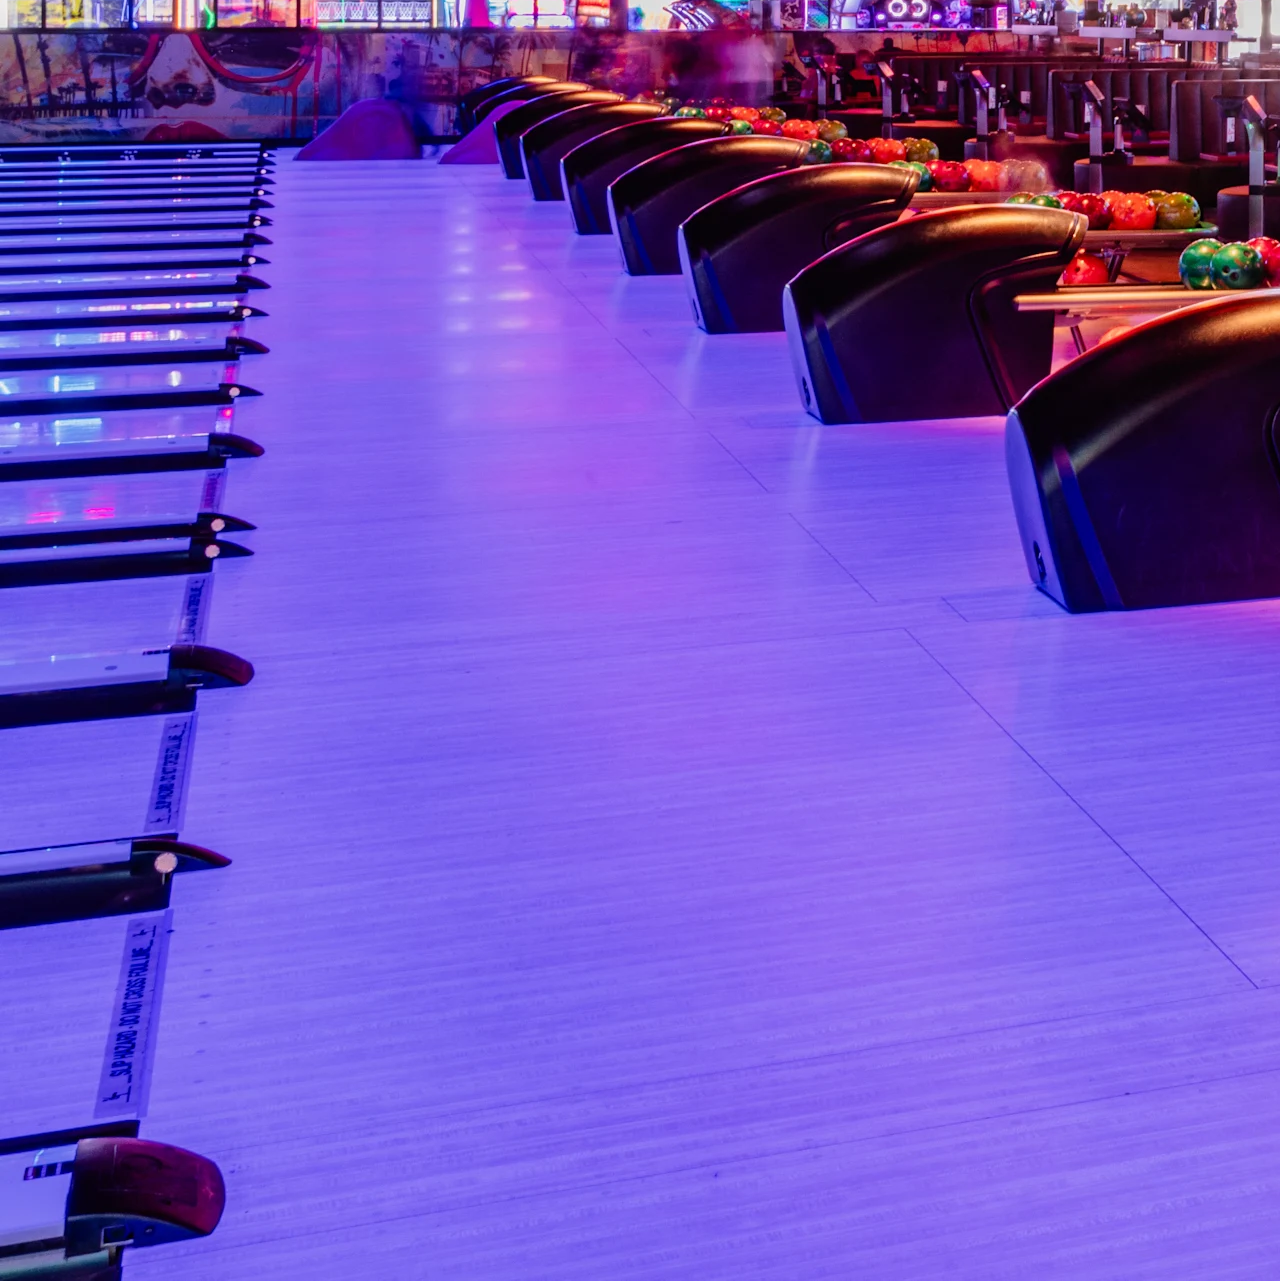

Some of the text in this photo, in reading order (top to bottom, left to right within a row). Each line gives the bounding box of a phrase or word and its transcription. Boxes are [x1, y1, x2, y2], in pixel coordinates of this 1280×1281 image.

[124, 977, 147, 1000] CROSS
[120, 1001, 143, 1015] NOT
[118, 1015, 141, 1027] DO
[113, 1030, 138, 1060] HAZARD
[110, 1060, 133, 1077] SLIP
